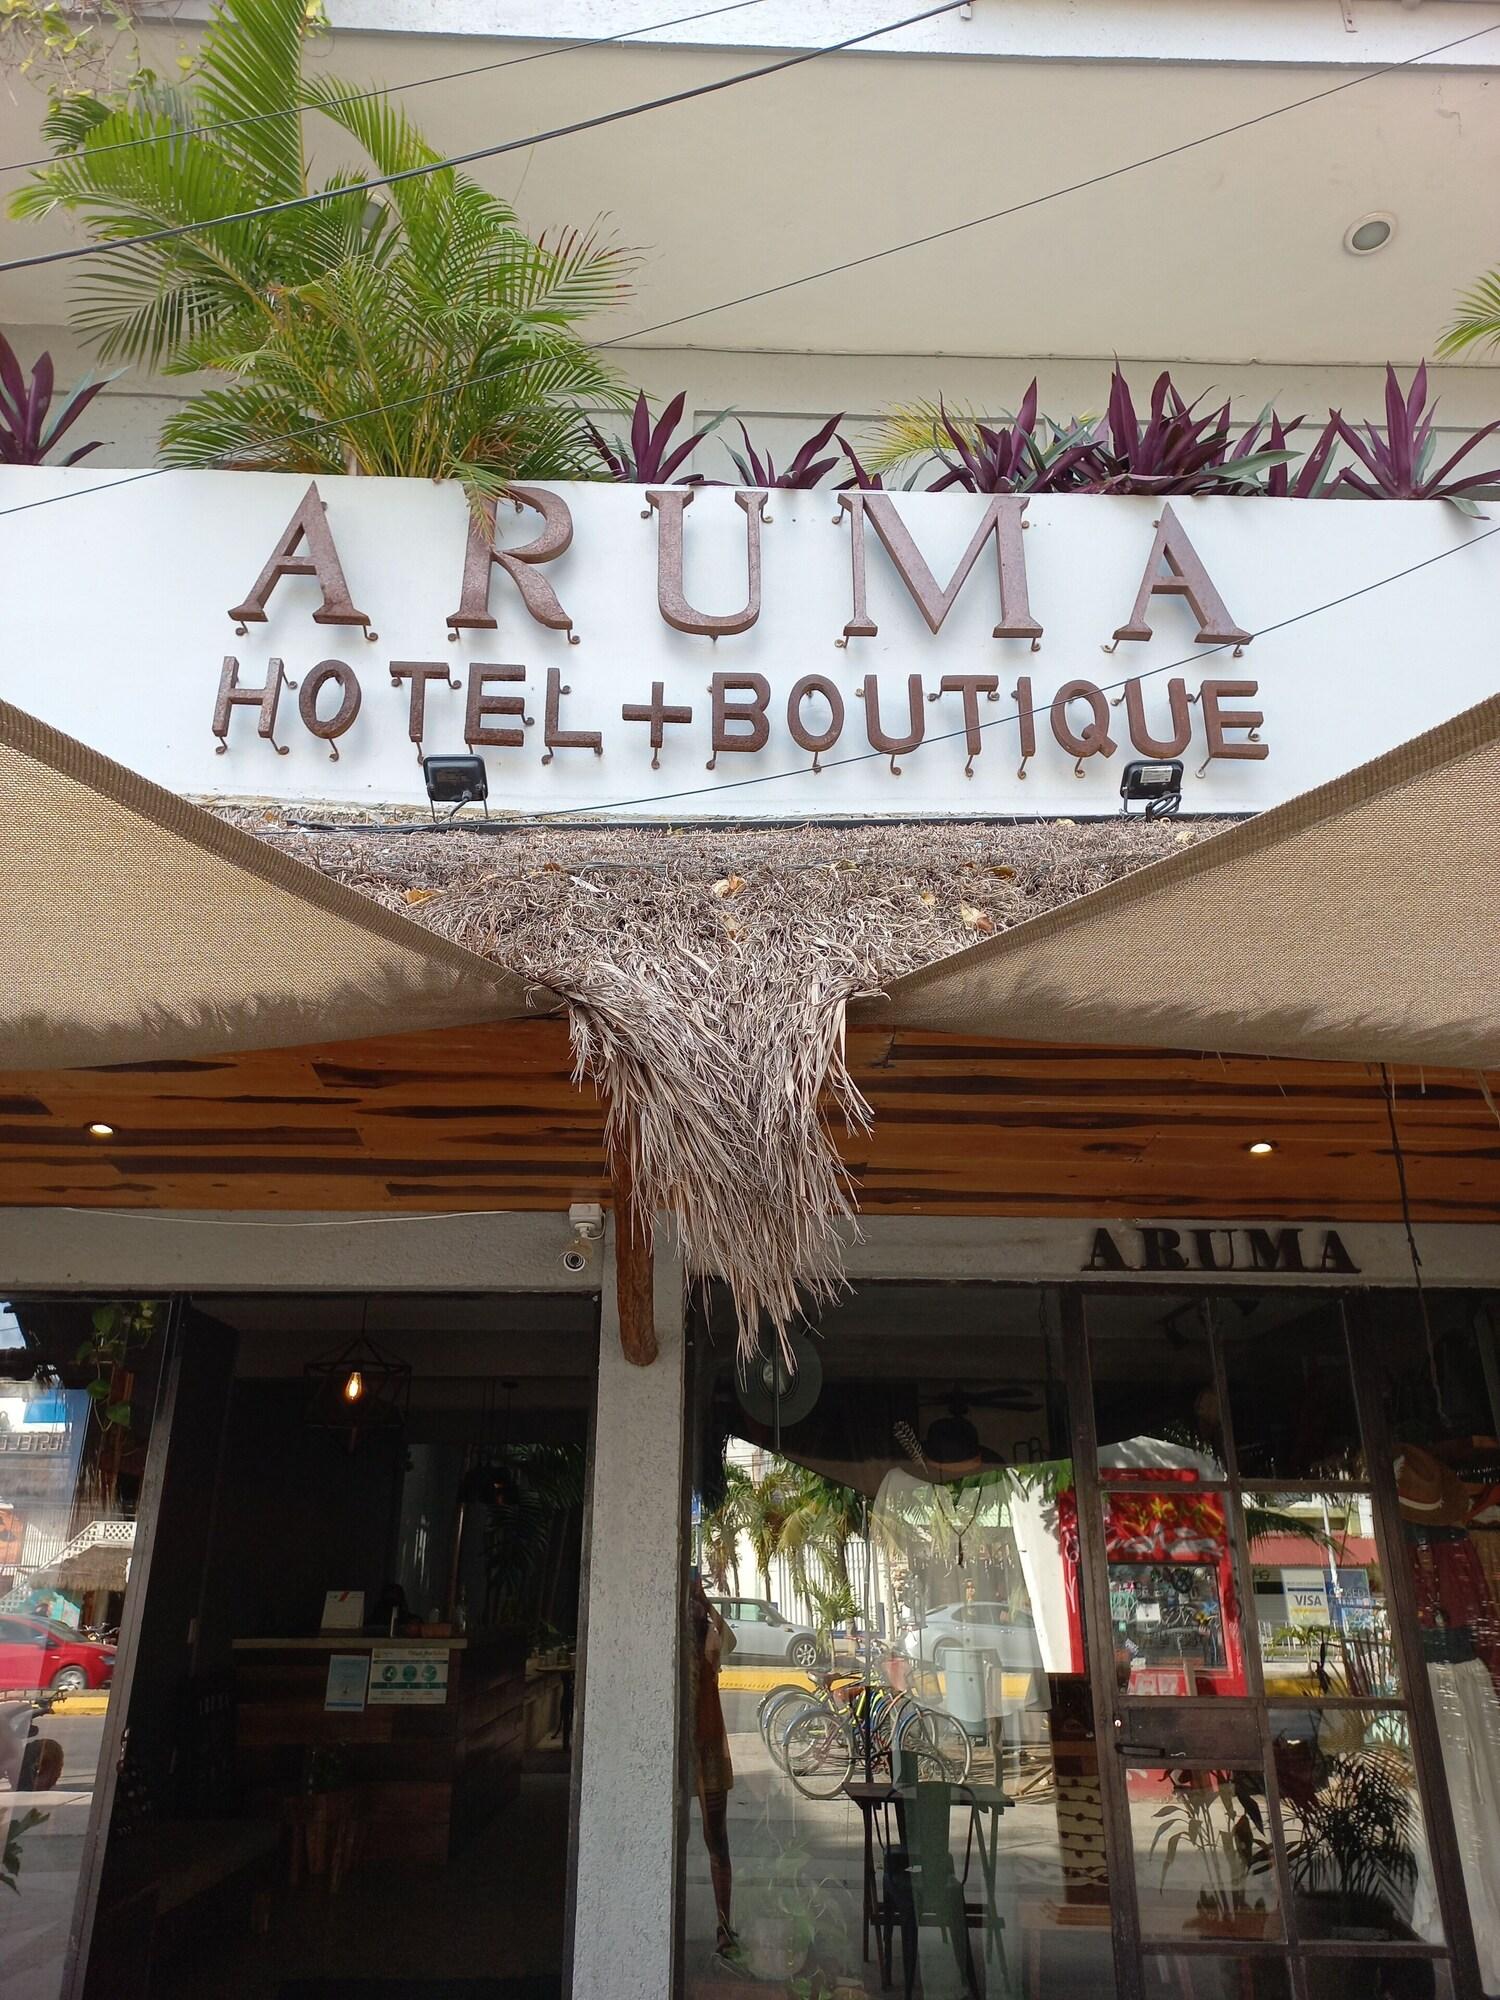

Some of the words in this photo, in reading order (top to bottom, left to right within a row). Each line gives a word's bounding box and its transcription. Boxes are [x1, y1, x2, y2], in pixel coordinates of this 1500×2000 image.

[228, 480, 1254, 644] ARUMA
[1081, 1227, 1361, 1273] ARUMA
[1294, 1595, 1322, 1606] VISA
